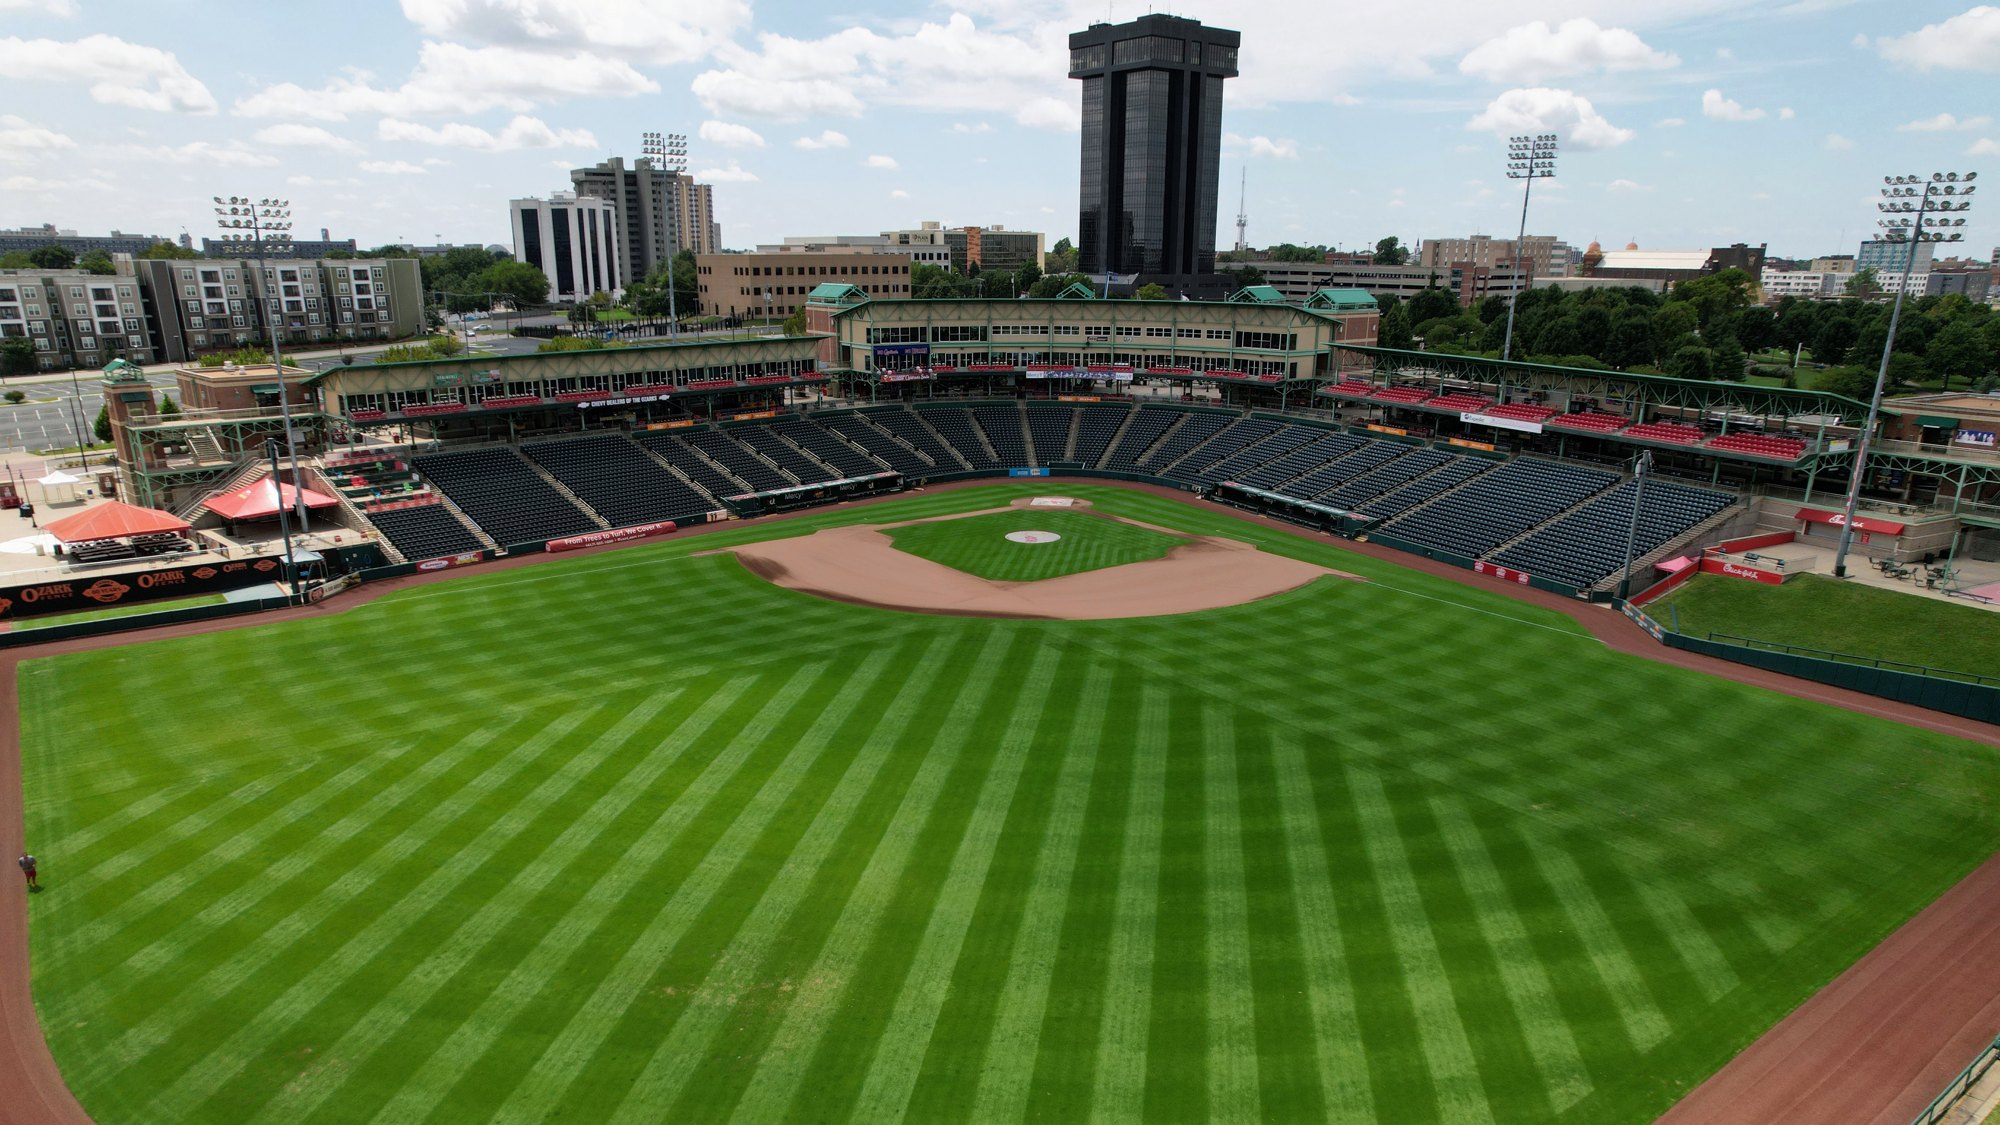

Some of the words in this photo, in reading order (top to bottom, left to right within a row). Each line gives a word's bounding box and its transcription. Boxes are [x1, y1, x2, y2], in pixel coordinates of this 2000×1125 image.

[564, 537, 582, 545] From
[584, 534, 602, 542] Trees
[611, 530, 626, 538] Turf,
[138, 571, 185, 588] OZARK
[21, 584, 73, 602] OZARK
